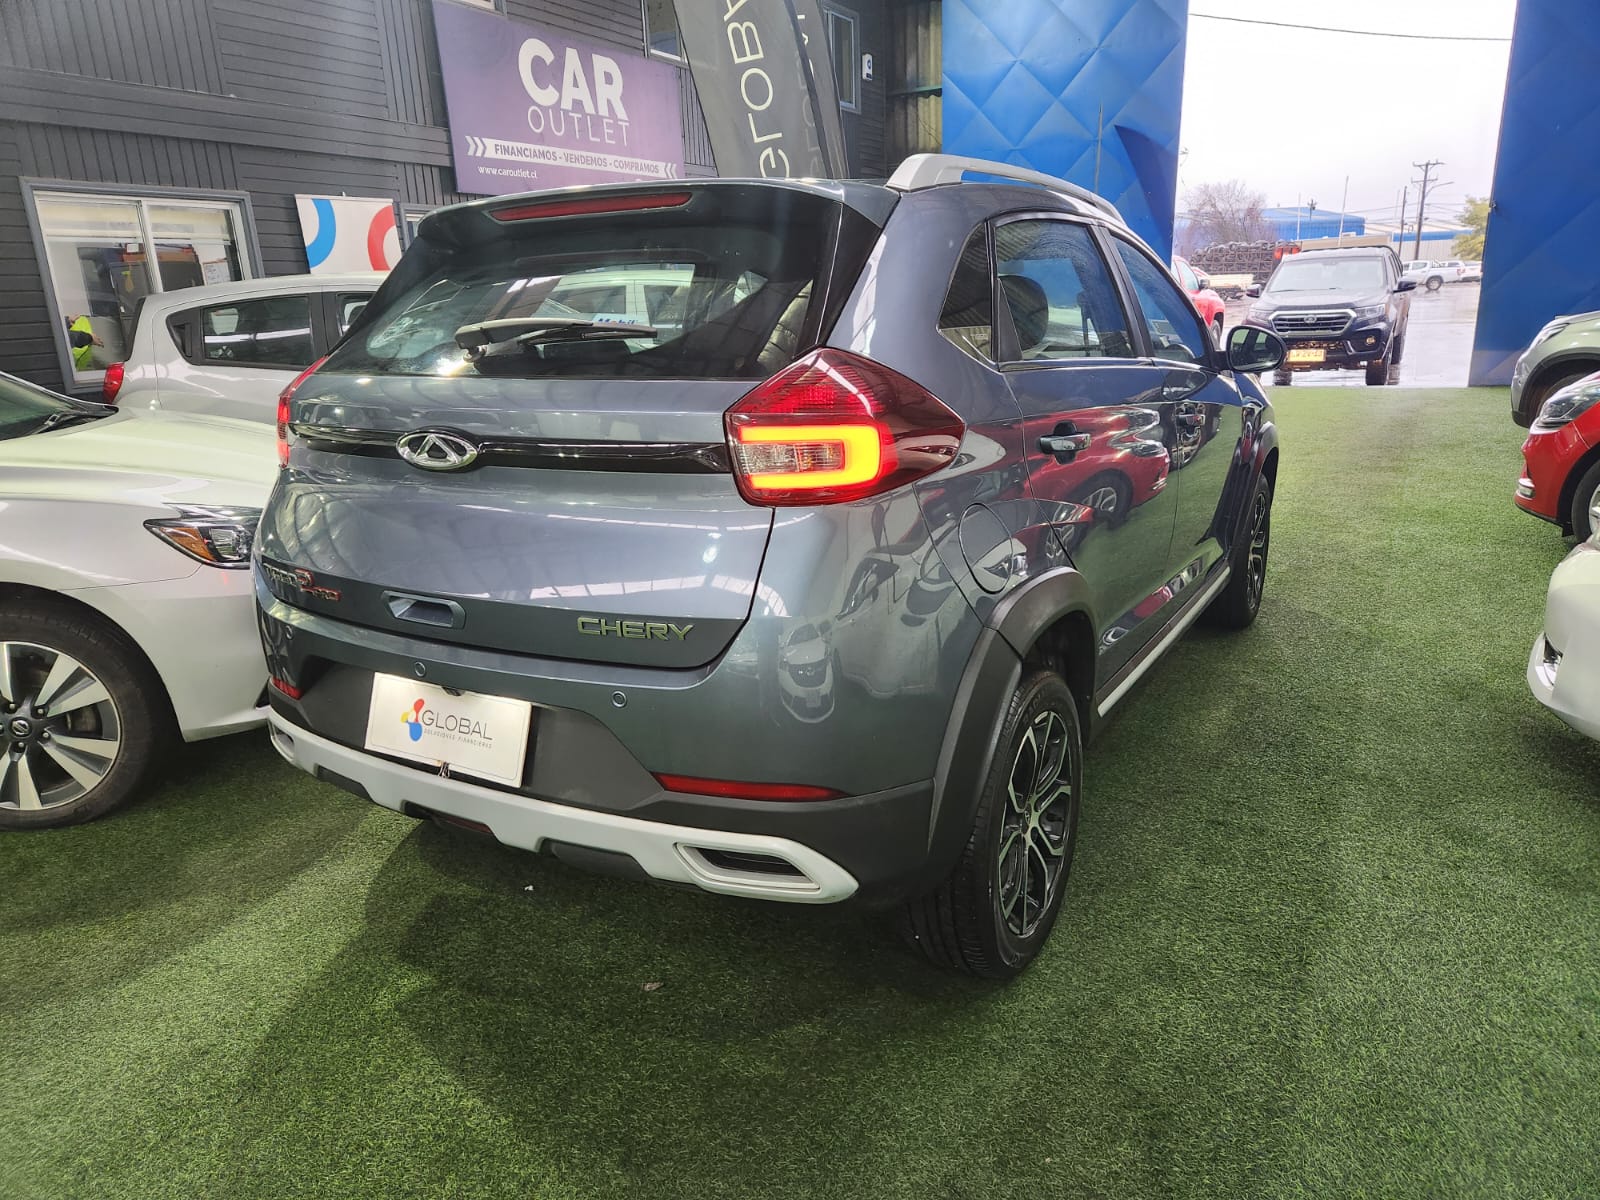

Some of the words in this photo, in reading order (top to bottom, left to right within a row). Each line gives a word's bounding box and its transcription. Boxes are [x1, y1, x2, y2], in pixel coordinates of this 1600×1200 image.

[518, 38, 629, 121] CAR
[527, 105, 629, 146] OUTLET
[494, 143, 558, 161] FINANCIAMOS
[563, 152, 608, 168] VENDEMOS
[613, 159, 660, 174] COMPRAMOS
[577, 617, 693, 641] CHERY
[421, 709, 493, 741] GLOBAL
